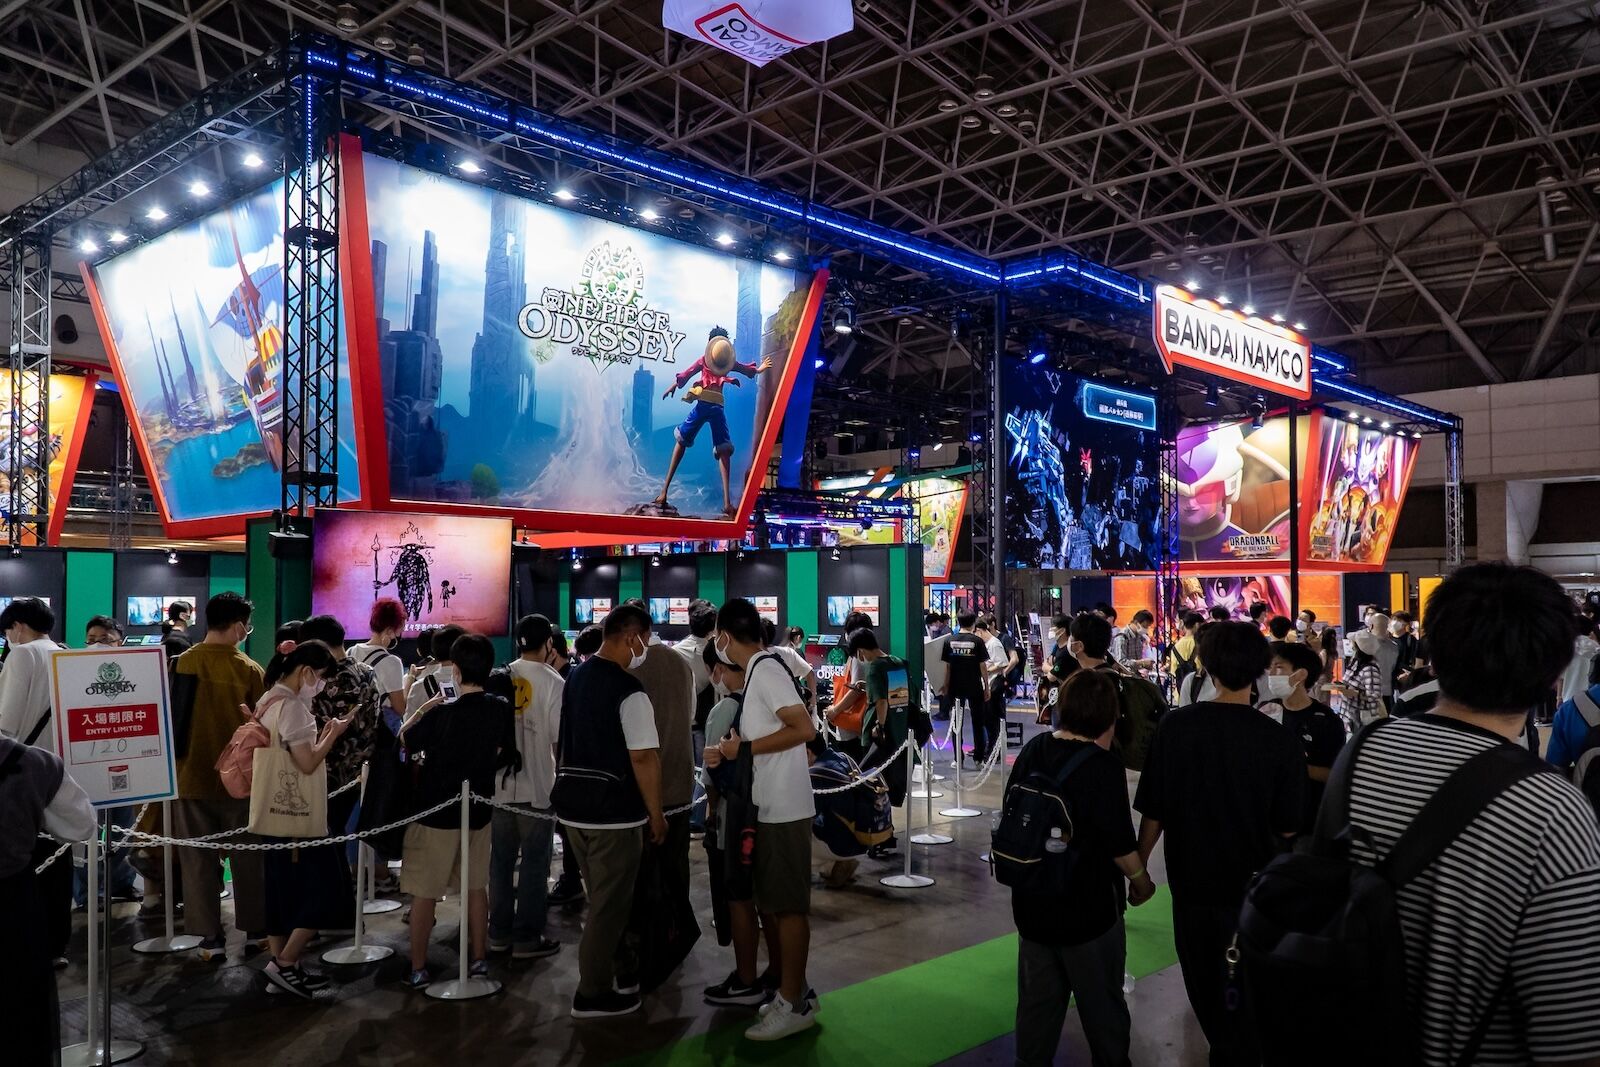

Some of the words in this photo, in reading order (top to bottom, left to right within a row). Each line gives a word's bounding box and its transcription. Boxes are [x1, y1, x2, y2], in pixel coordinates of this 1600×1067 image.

[541, 287, 597, 318] ONE
[599, 301, 671, 333] PIECE
[518, 303, 687, 363] ODYSSEY
[1166, 308, 1238, 363] BANDAI
[1243, 335, 1303, 383] NAMCO
[85, 684, 137, 695] ODYSSEY
[81, 710, 147, 726] 入場制限中
[85, 728, 112, 736] ENTRY
[113, 725, 144, 733] LIMITED
[90, 738, 127, 757] 120
